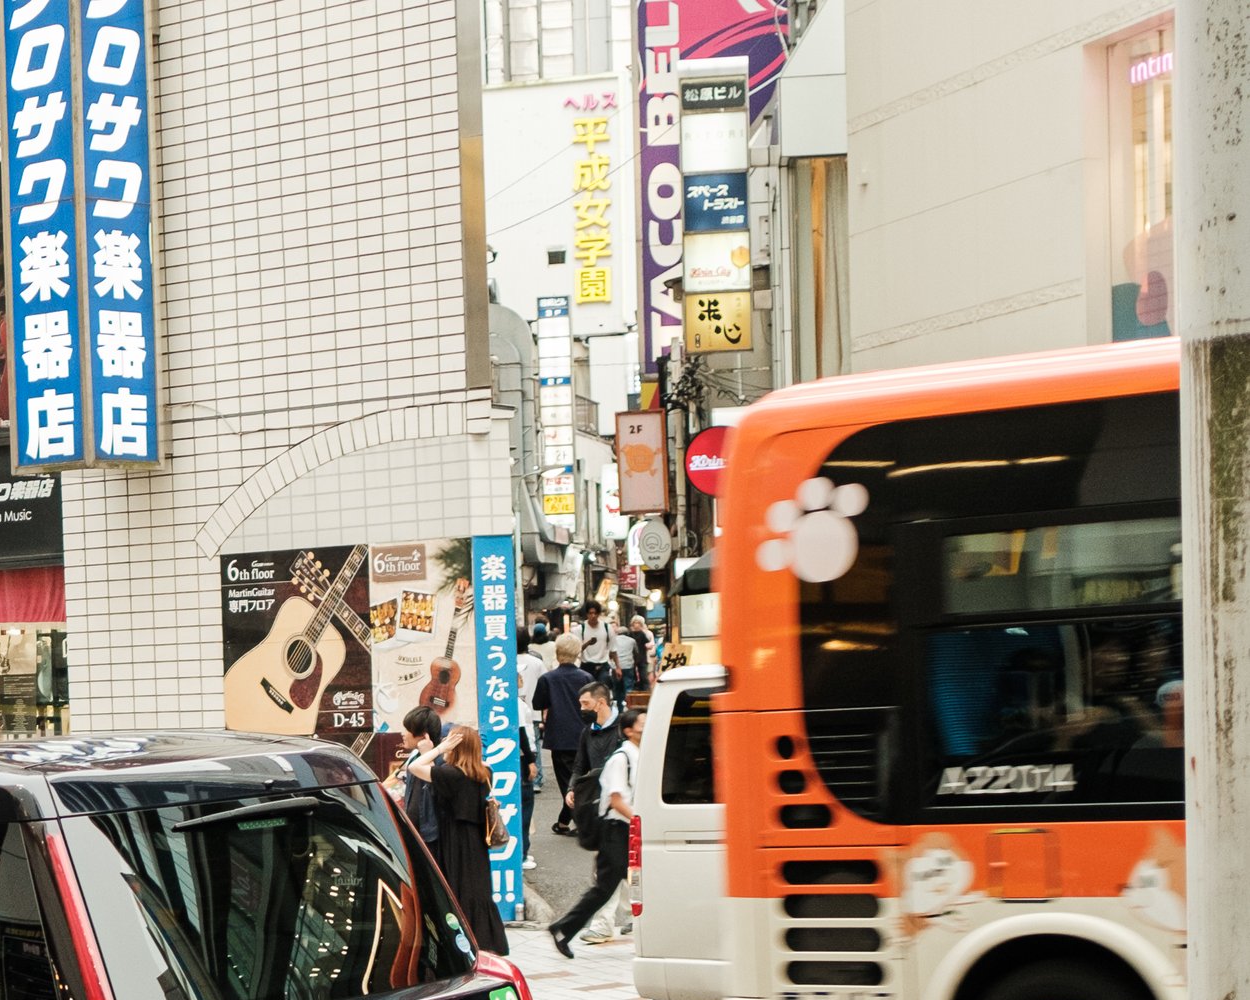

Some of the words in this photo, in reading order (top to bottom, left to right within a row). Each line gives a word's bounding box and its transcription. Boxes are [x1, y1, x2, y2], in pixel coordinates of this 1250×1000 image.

[562, 91, 618, 111] ヘルス
[684, 86, 743, 102] 松原ビル
[686, 184, 730, 198] スペース
[573, 116, 612, 304] 平成女学園
[702, 197, 745, 211] トラスト
[629, 424, 643, 434] 2F
[3, 507, 32, 522] Music
[227, 559, 250, 582] 6th
[251, 568, 275, 580] floor
[373, 552, 396, 574] 6th
[397, 560, 421, 573] floor
[228, 598, 275, 613] 専門フロア
[333, 712, 365, 728] D-45
